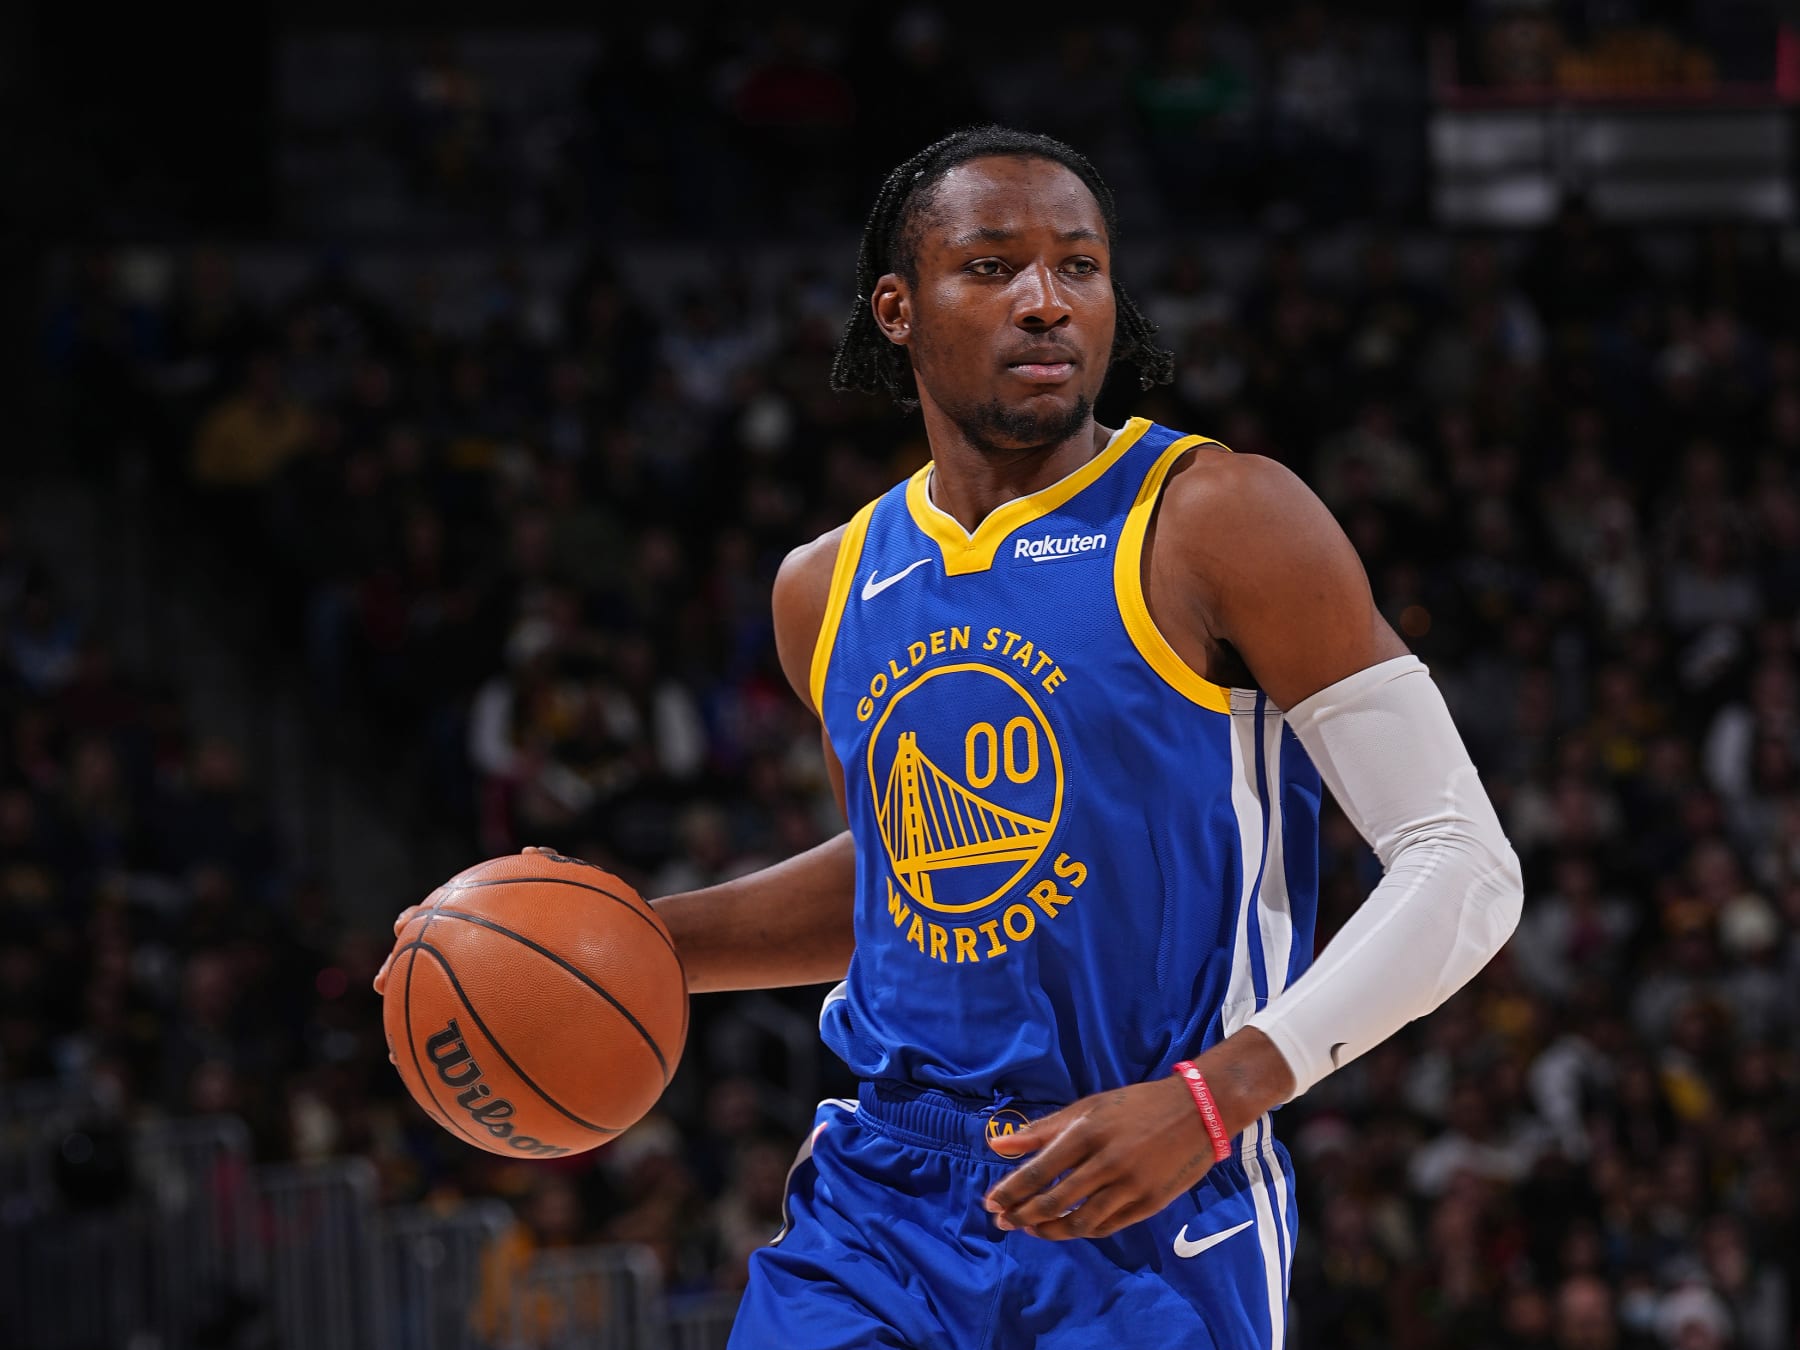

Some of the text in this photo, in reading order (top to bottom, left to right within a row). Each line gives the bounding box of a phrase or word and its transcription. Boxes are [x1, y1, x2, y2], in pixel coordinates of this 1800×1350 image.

[1014, 533, 1107, 559] Rakuten
[856, 625, 1067, 722] GOLDEN STATE
[964, 716, 1039, 789] 00
[885, 851, 1089, 964] WARRIORS
[427, 1019, 571, 1156] Wilson
[1191, 1081, 1223, 1138] Mambacita
